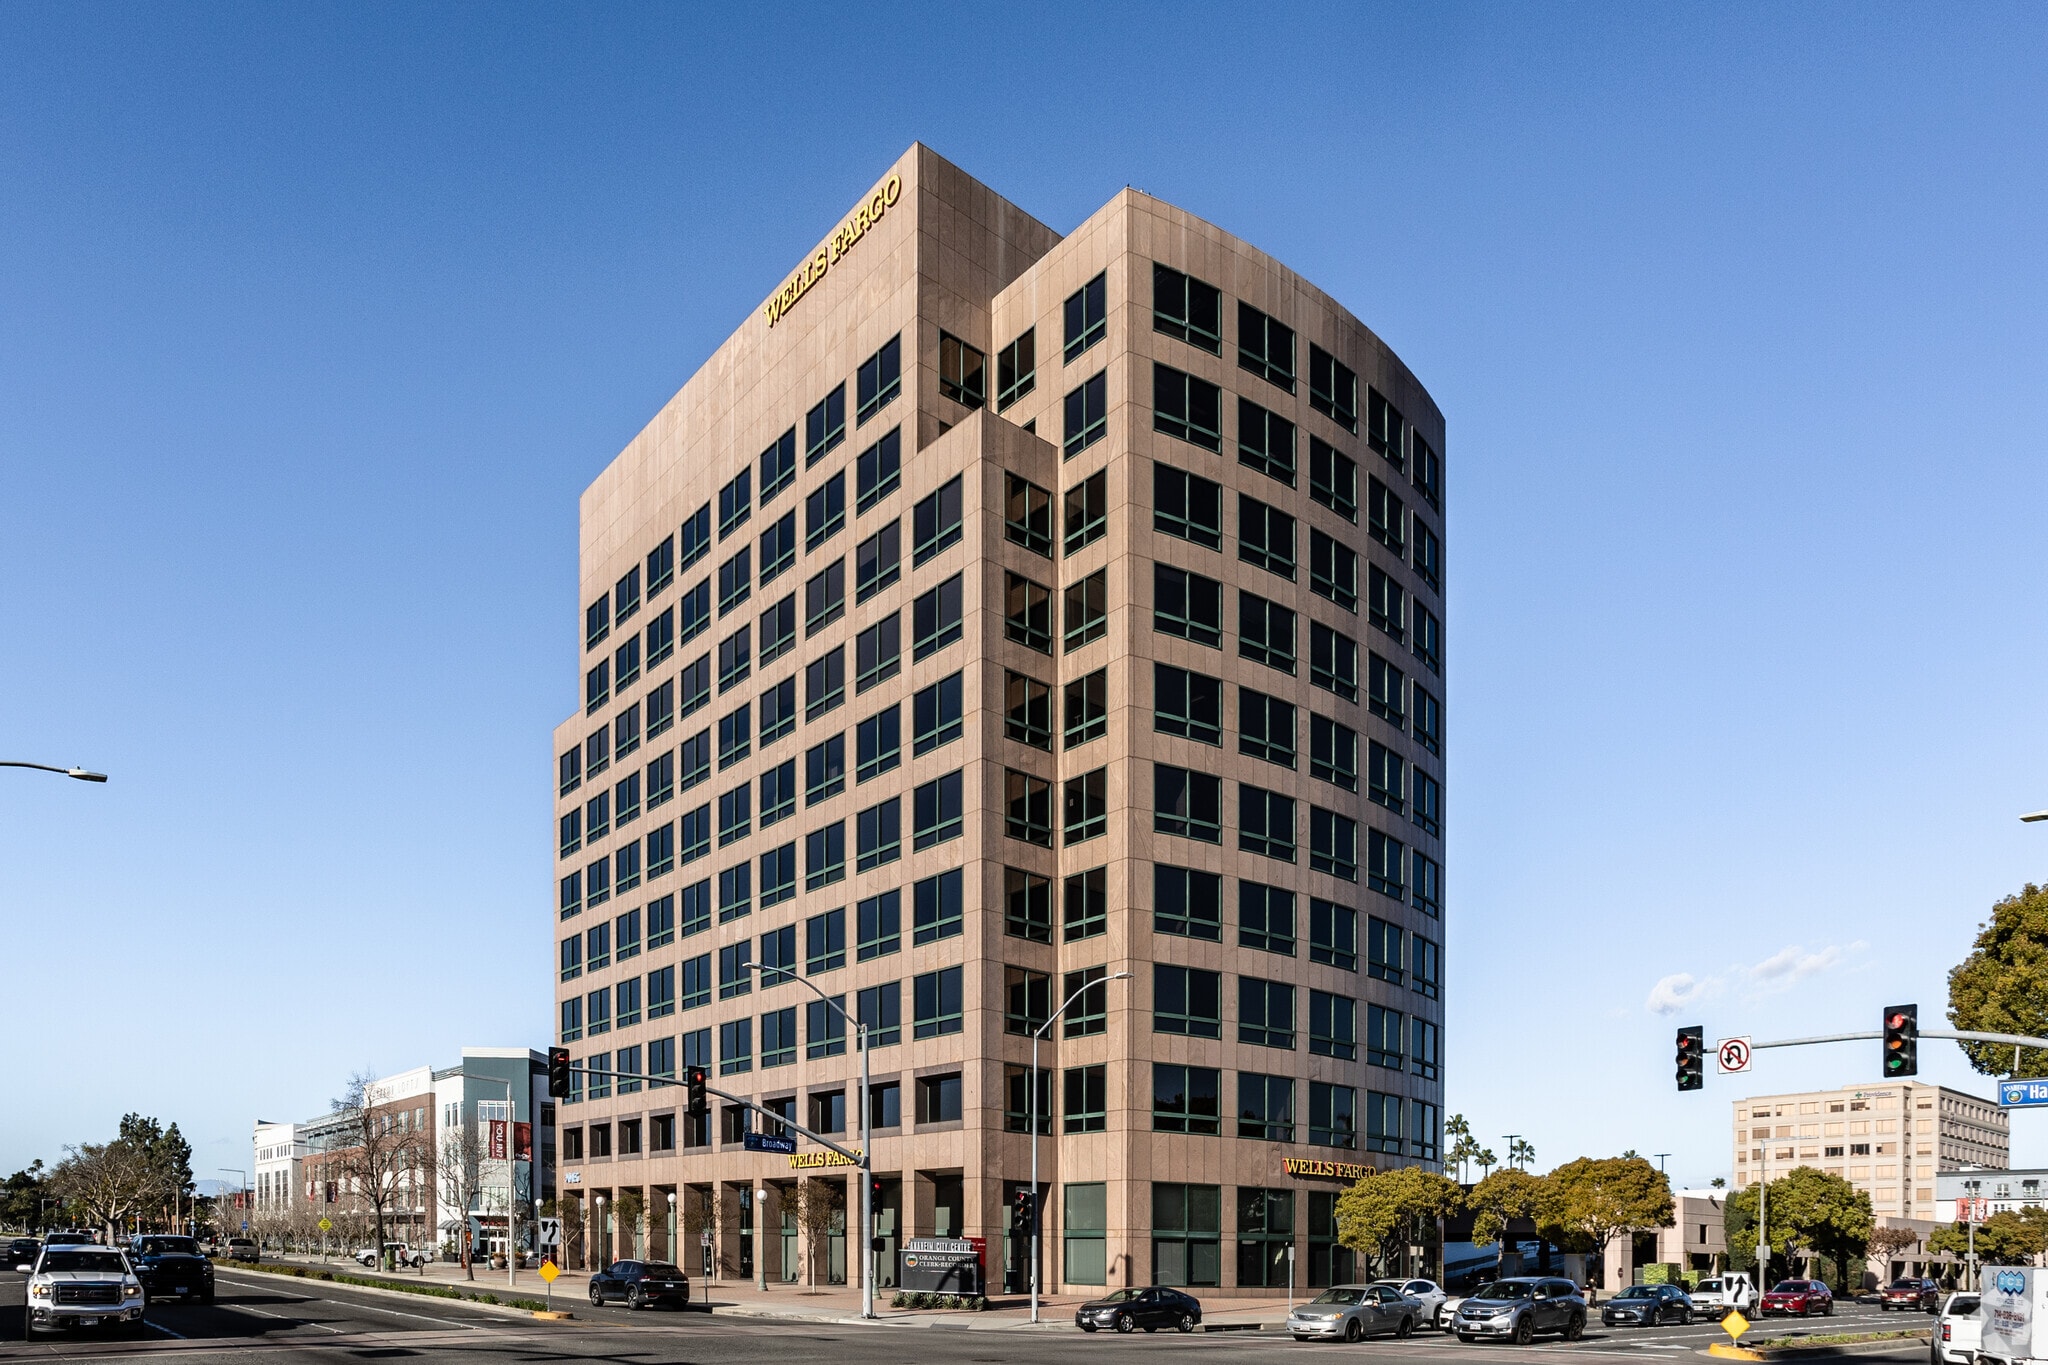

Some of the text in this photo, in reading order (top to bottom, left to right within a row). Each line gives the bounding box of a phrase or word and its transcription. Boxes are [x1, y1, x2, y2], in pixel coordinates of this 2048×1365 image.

[764, 174, 901, 327] WELLS FARGO
[2030, 1084, 2048, 1099] Ha
[761, 1138, 793, 1152] Broadway
[788, 1152, 825, 1169] WELLS
[1282, 1157, 1377, 1180] WELLS FARGO
[909, 1241, 934, 1251] ANAHEIM
[936, 1242, 950, 1251] CITY
[950, 1242, 971, 1252] CENTRE
[1999, 1277, 2024, 1287] ICE
